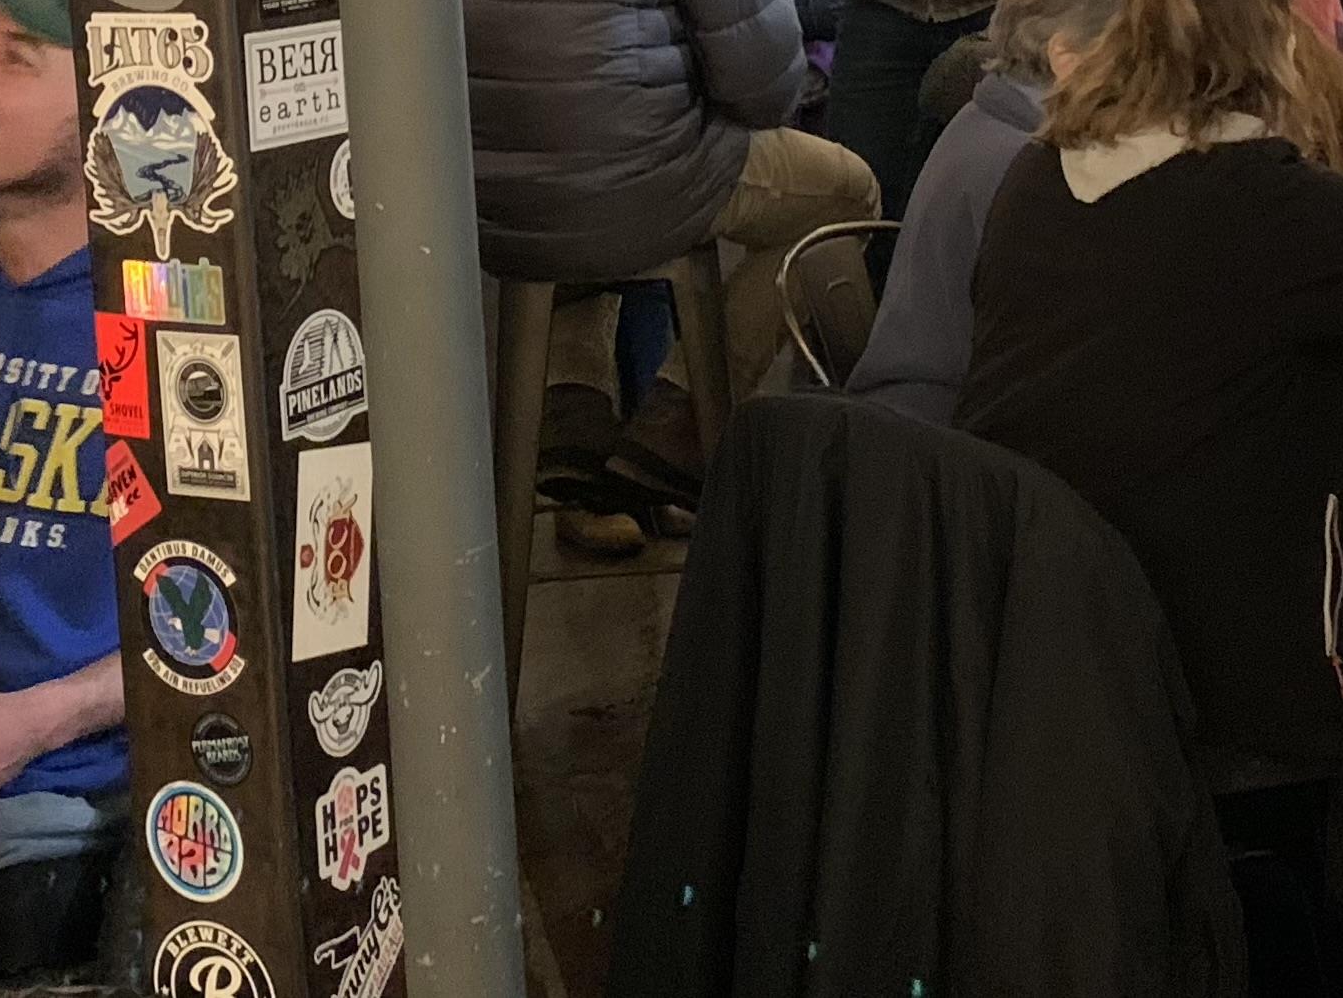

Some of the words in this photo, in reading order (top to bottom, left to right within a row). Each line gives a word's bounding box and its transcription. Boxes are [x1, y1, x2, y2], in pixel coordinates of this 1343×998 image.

[88, 26, 211, 81] LAT65
[110, 70, 169, 93] BREWING
[259, 88, 341, 123] earth
[80, 368, 103, 396] O
[287, 368, 363, 418] PINELANDS
[109, 404, 143, 419] SHOVEL
[139, 543, 187, 574] DANTIBUS
[191, 545, 230, 579] DAMUS
[162, 667, 180, 687] AIR
[182, 671, 232, 693] REFUELING
[157, 793, 233, 852] MORRO
[157, 828, 233, 889] BAY
[166, 925, 255, 966] BLEWETT
